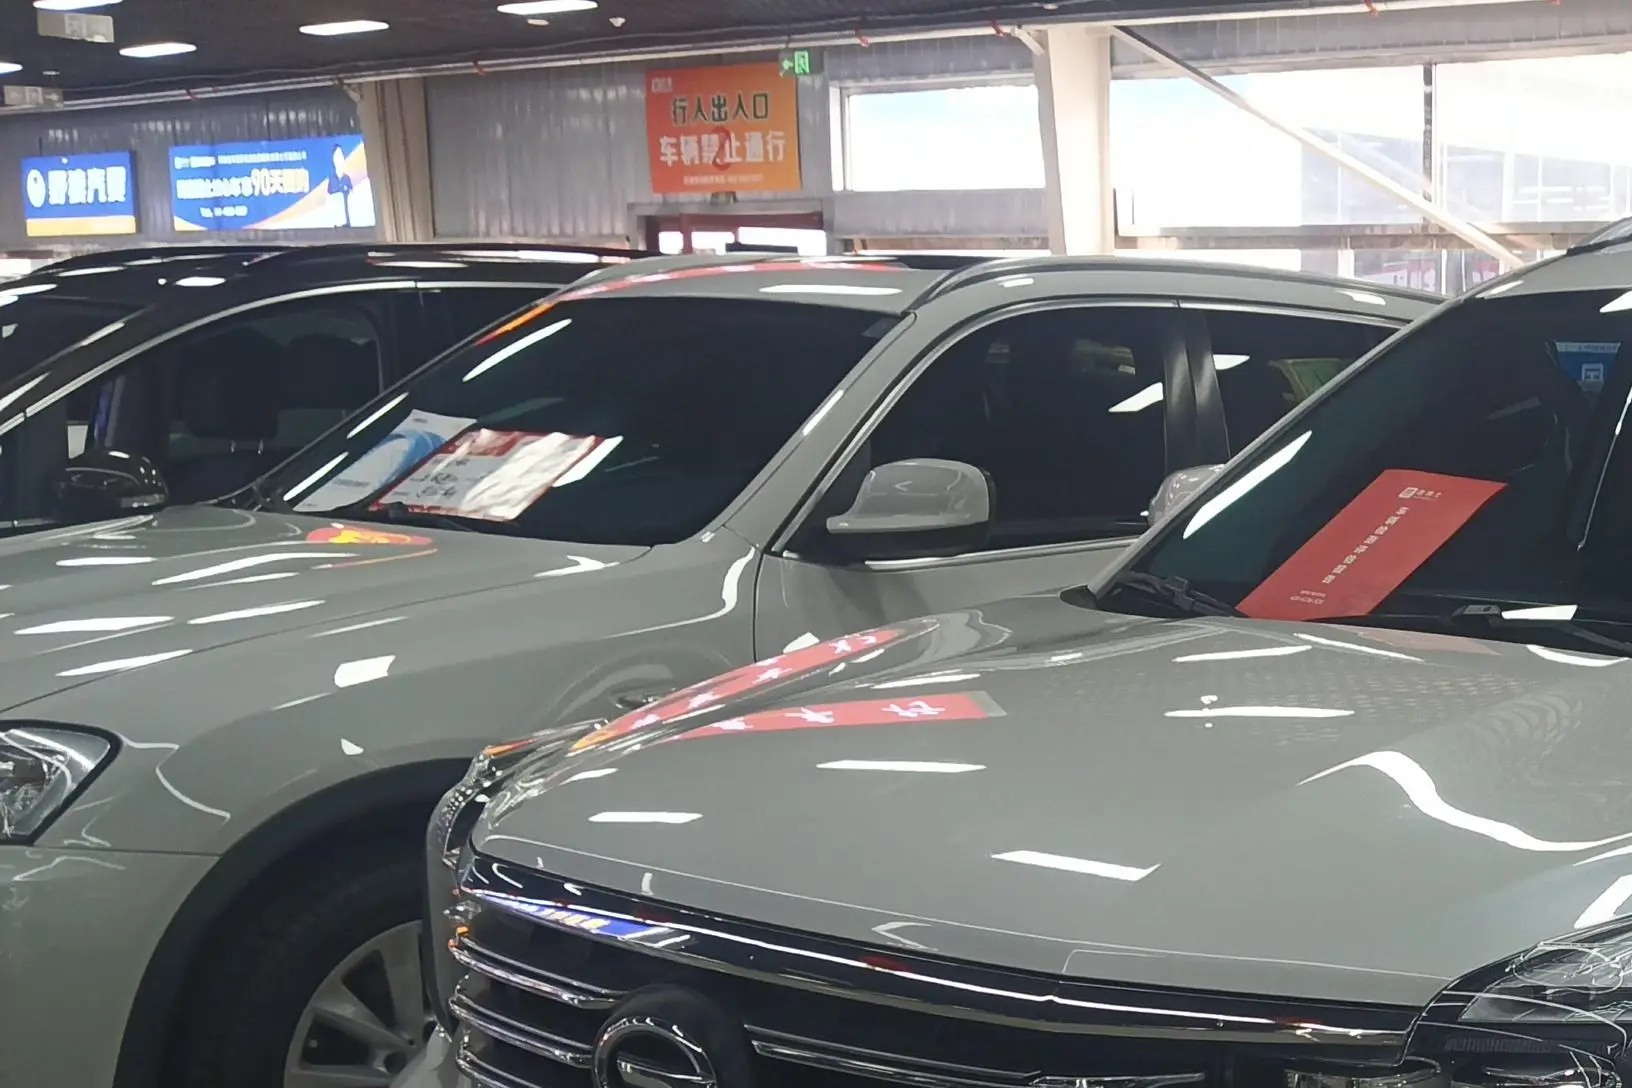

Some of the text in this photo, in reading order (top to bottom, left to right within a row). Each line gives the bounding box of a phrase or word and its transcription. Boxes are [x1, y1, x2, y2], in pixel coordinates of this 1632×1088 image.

[672, 92, 769, 126] 行人出入口
[659, 130, 786, 167] 车辆禁止通行
